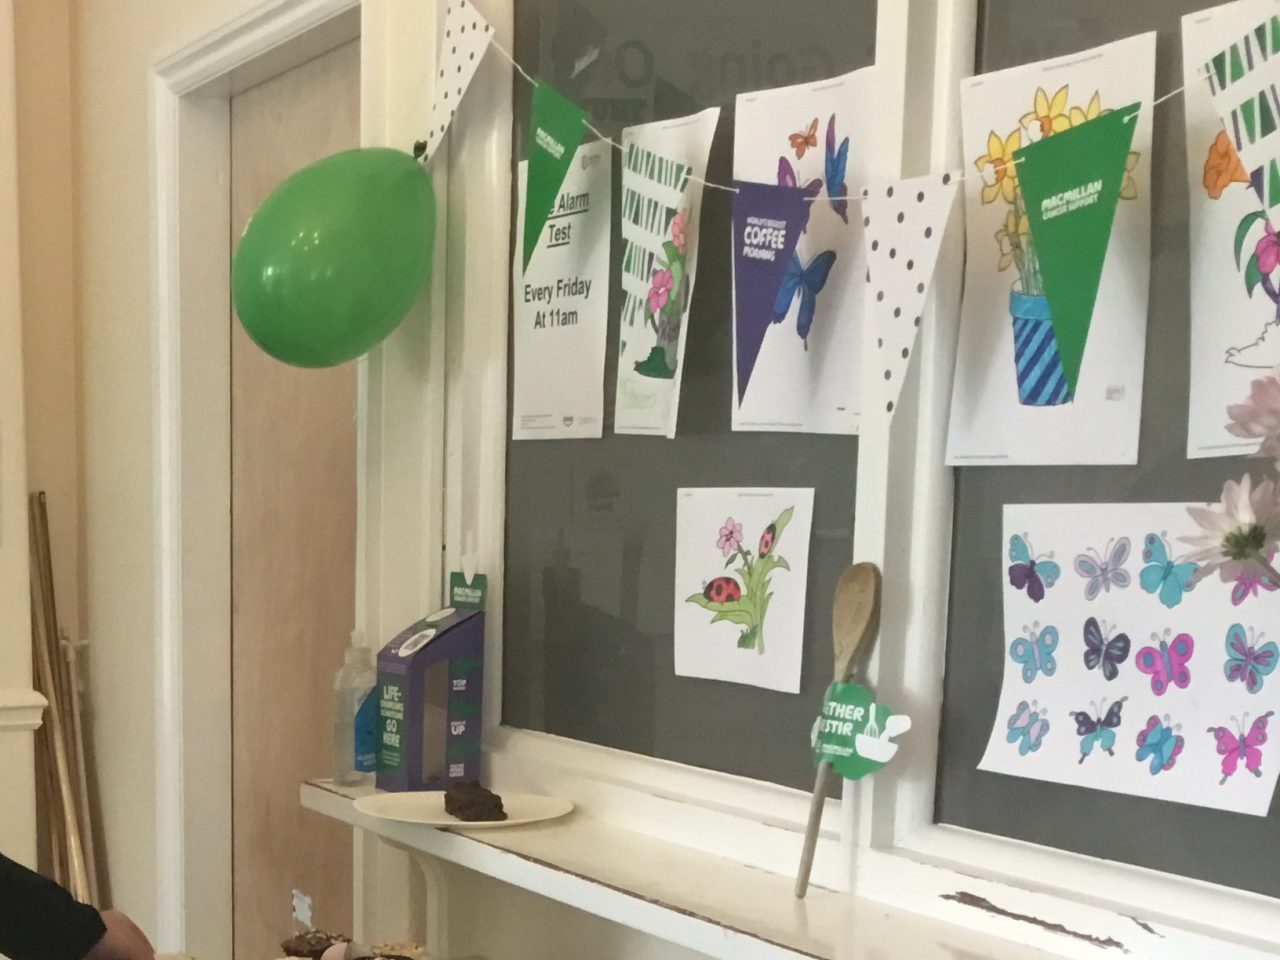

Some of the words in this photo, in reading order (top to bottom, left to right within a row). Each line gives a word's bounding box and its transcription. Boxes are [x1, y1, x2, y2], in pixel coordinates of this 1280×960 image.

[557, 192, 590, 213] Alarm
[1041, 179, 1102, 212] MACMILLAN
[548, 223, 572, 243] Test
[743, 225, 787, 250] COFFEE
[524, 284, 554, 305] Every
[556, 277, 592, 300] Friday
[533, 312, 547, 330] At
[549, 308, 579, 328] 11am
[385, 718, 398, 734] GO
[451, 725, 466, 736] UP
[382, 731, 400, 748] HERE
